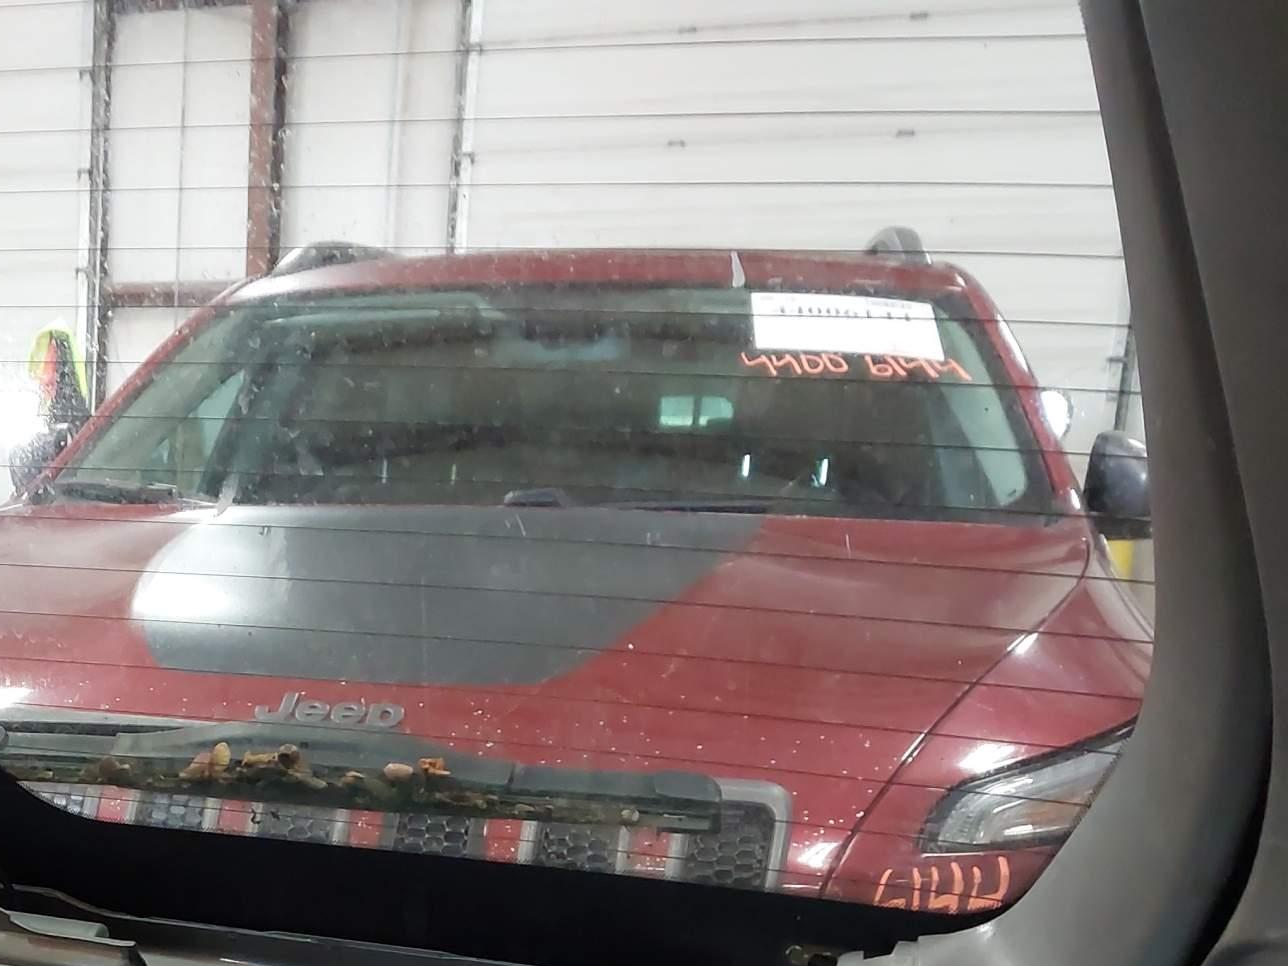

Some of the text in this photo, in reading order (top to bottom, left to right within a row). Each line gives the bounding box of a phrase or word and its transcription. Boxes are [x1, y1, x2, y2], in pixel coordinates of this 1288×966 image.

[741, 352, 972, 381] 4400 6144
[254, 692, 405, 728] Jeep
[873, 856, 1010, 914] 6144
